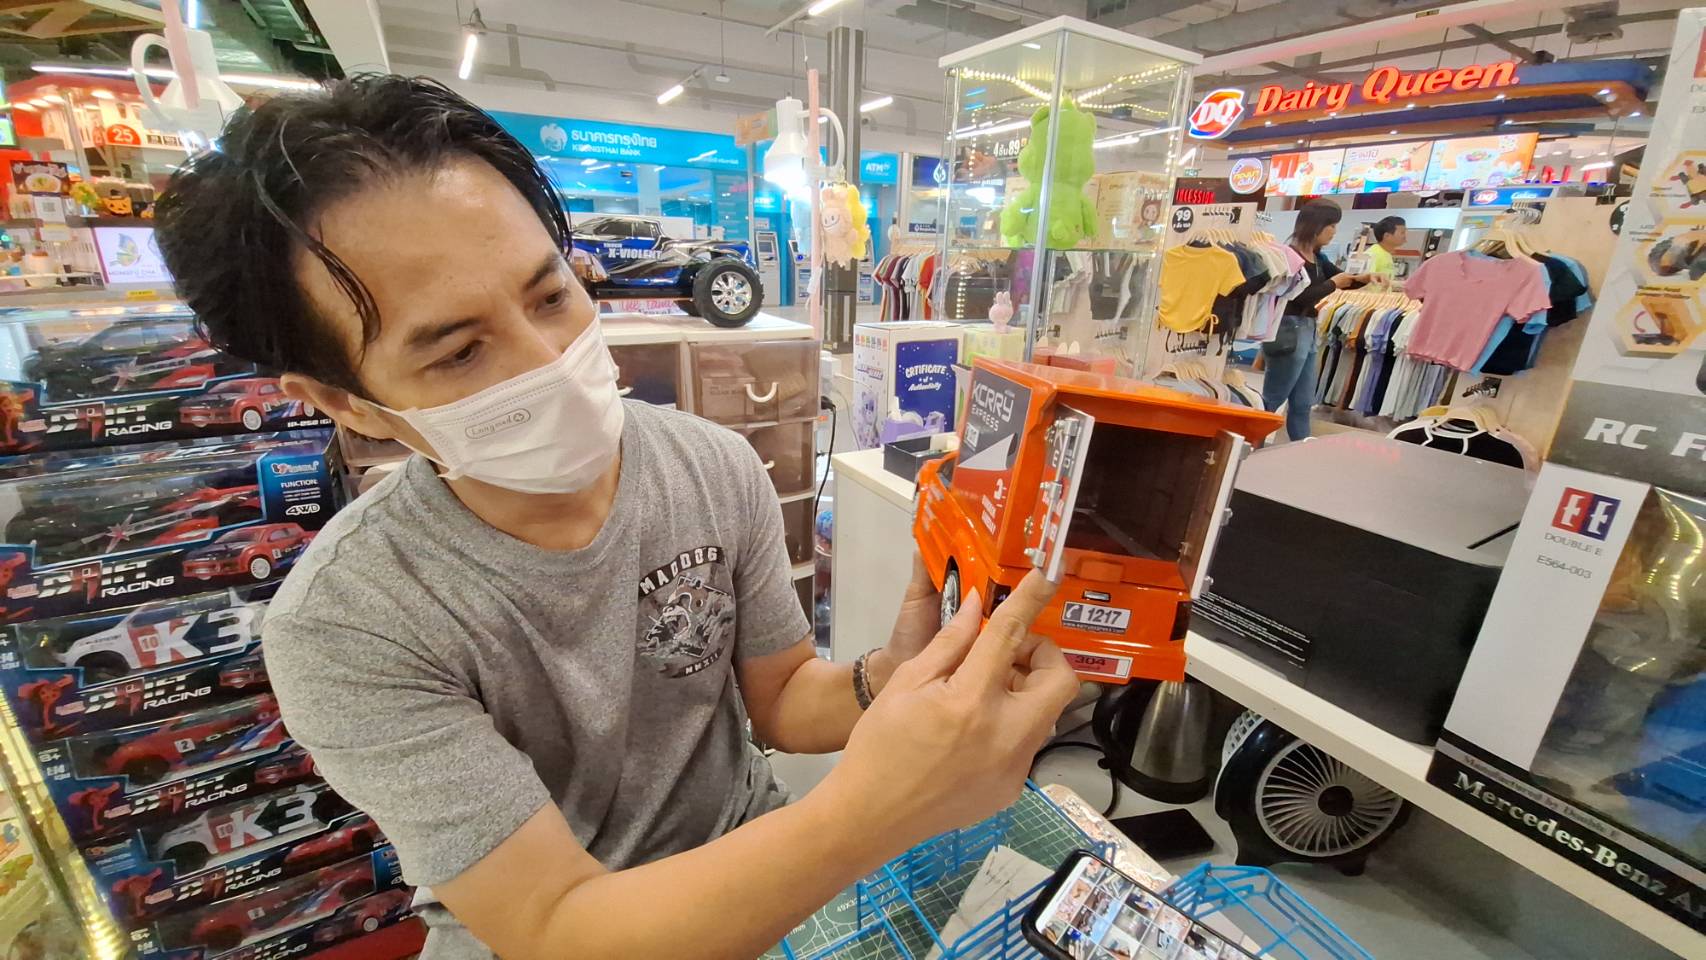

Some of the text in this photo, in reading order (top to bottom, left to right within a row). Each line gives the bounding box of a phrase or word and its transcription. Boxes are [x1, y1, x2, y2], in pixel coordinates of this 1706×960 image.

[1254, 82, 1351, 117] Dairy
[1199, 98, 1235, 126] DQ
[112, 128, 134, 142] 25
[571, 129, 657, 149] ธนาคารกรุงไทย
[572, 144, 641, 156] KNGTHAI BANK
[865, 162, 883, 172] ATM
[608, 247, 662, 259] X-VIOLENT
[971, 403, 999, 432] EXPRESS
[105, 420, 173, 438] RACING
[1584, 417, 1706, 462] RC F
[286, 503, 320, 516] 4WD
[1544, 532, 1593, 553] DOUBLE
[639, 547, 718, 595] MADDOG
[1536, 555, 1592, 580] E564-003
[101, 575, 174, 598] RACING
[1087, 608, 1122, 625] 1217
[141, 636, 160, 650] 10
[1075, 655, 1106, 666] 304
[143, 686, 212, 710] RACING
[184, 783, 248, 809] RACING
[1453, 771, 1668, 897] Mercedes-Benz
[224, 867, 282, 894] RACING
